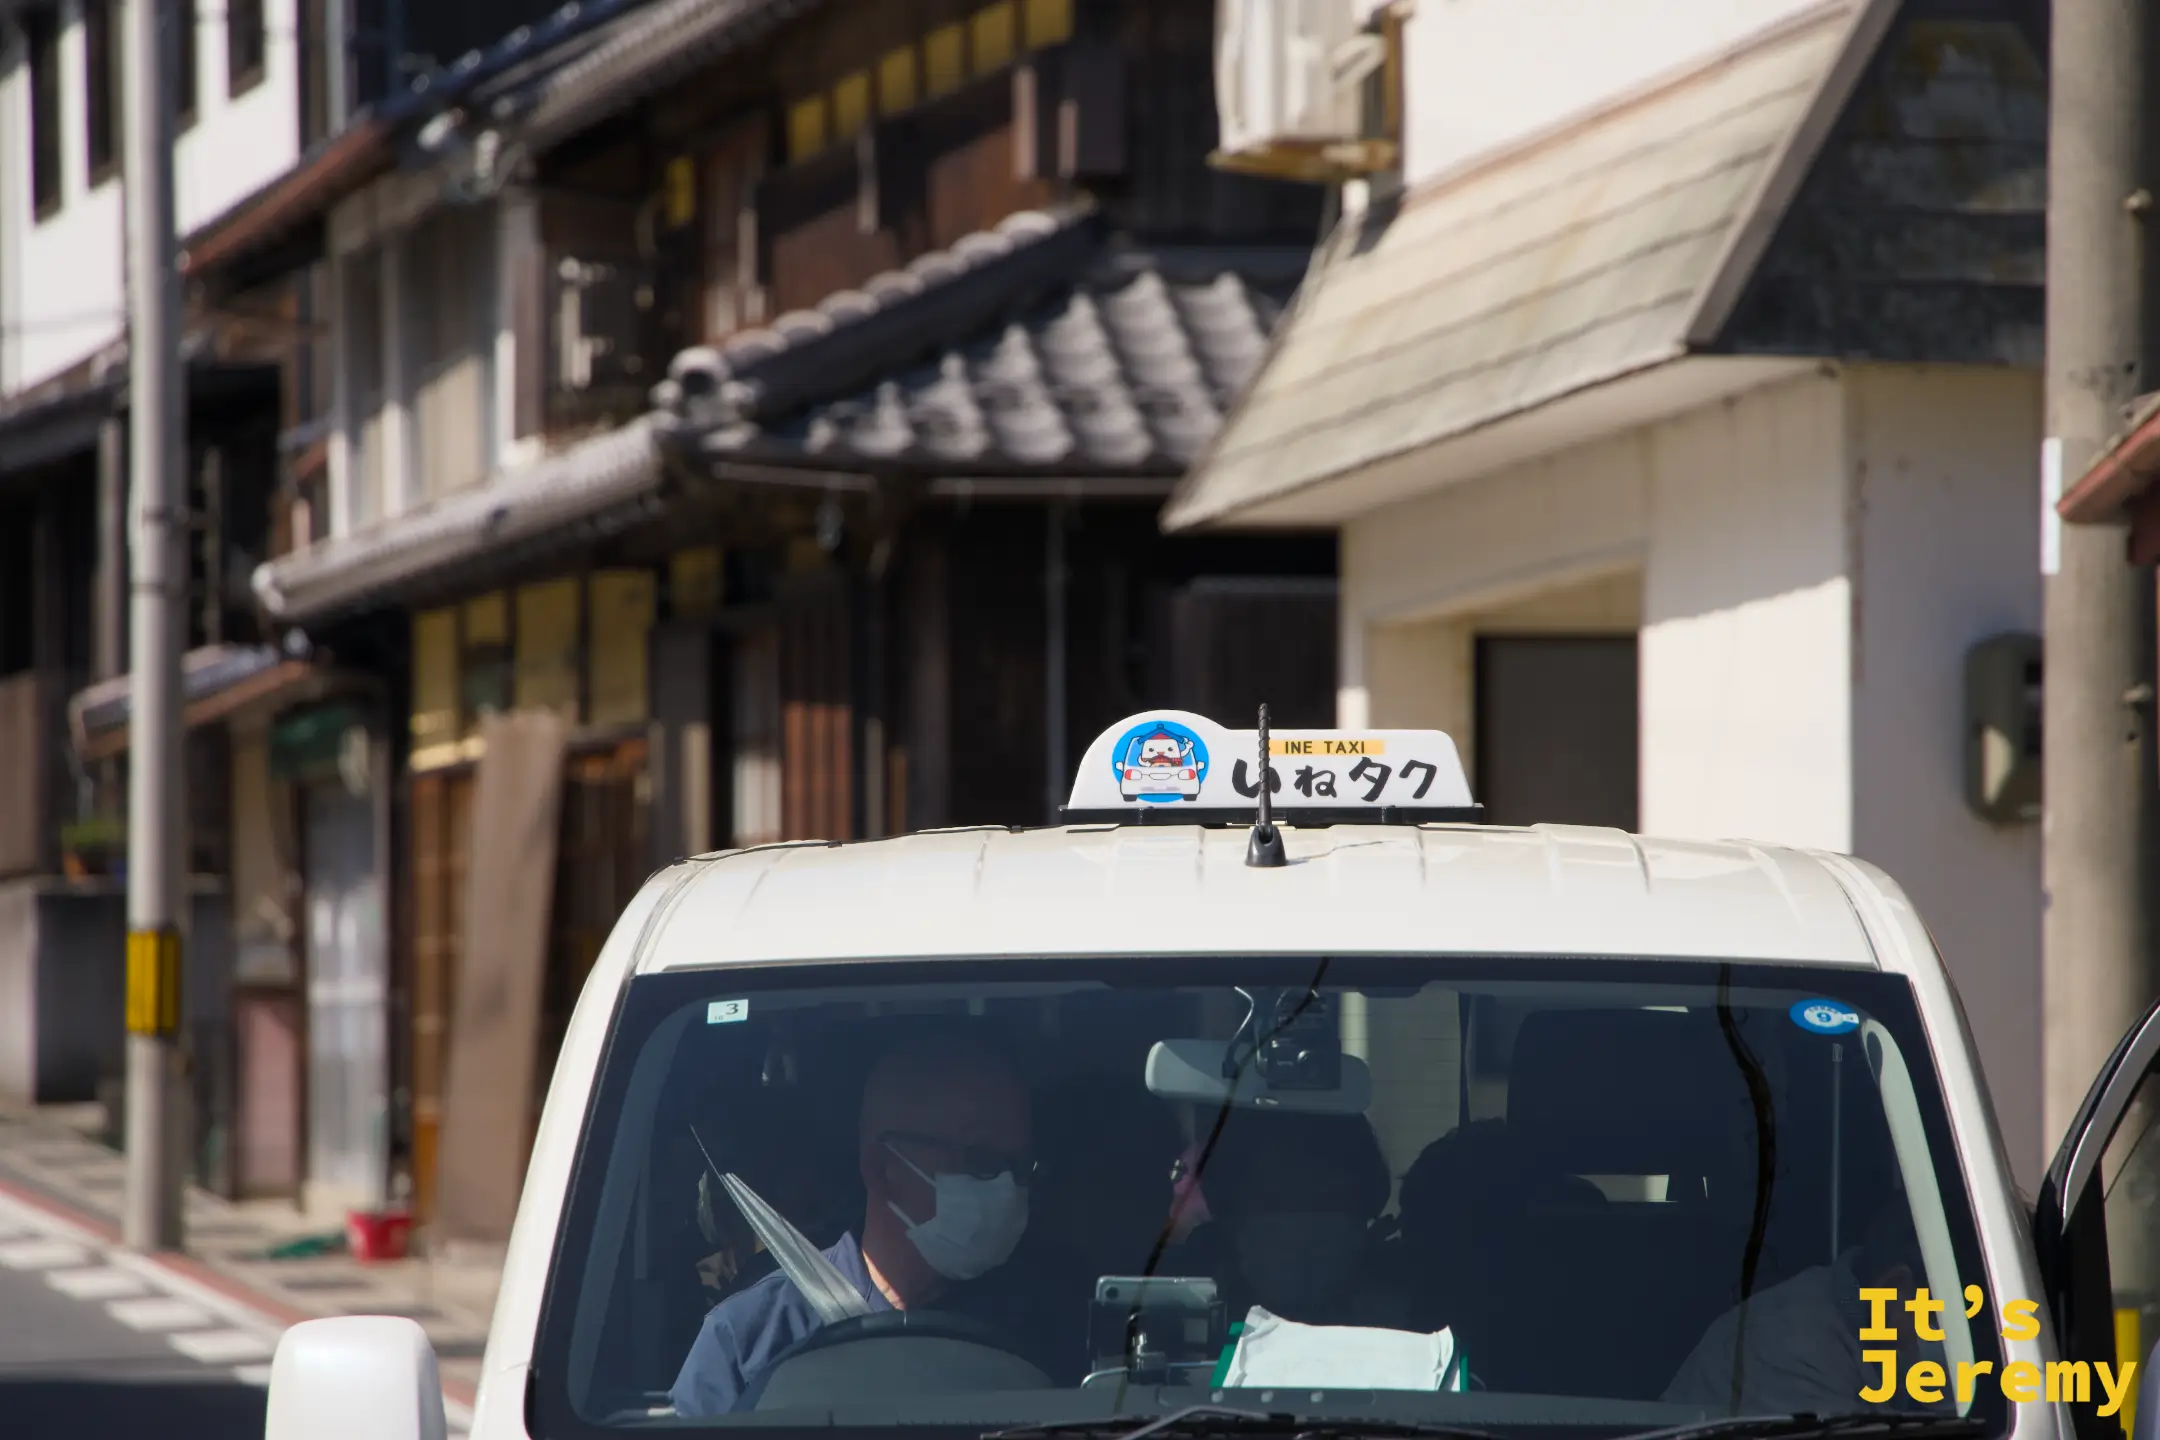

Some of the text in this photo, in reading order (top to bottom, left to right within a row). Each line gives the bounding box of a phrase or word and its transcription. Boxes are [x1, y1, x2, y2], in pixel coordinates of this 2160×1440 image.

[1285, 740, 1366, 754] INE TAXI
[1231, 757, 1438, 802] いねタク
[725, 1003, 739, 1015] 3
